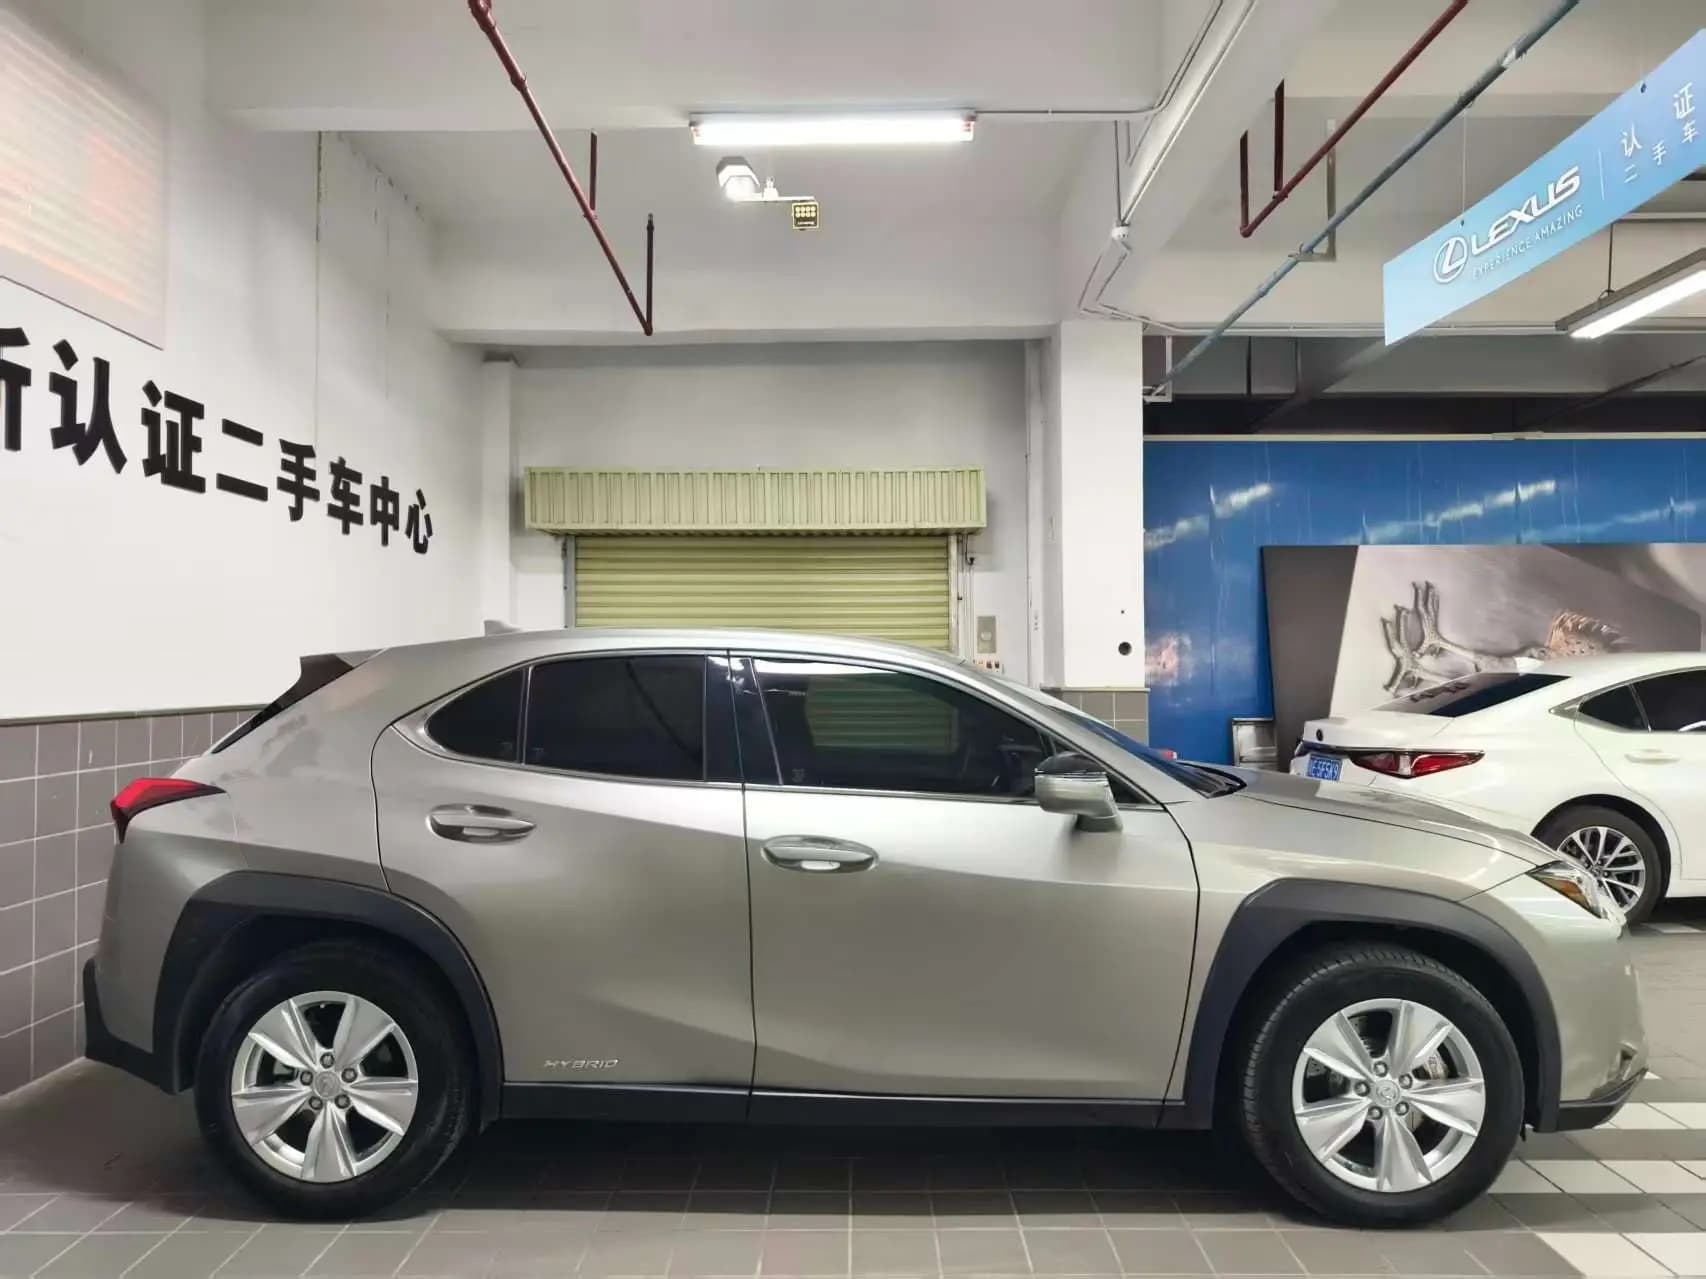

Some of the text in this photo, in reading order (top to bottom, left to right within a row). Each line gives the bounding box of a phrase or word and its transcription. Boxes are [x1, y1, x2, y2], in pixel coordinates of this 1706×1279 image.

[1620, 82, 1696, 157] 认证
[1623, 120, 1699, 183] 二手车
[1471, 166, 1581, 256] LEXUS
[1472, 204, 1583, 280] EXPERIENCE AMAZING
[543, 1059, 619, 1069] HYBRID
